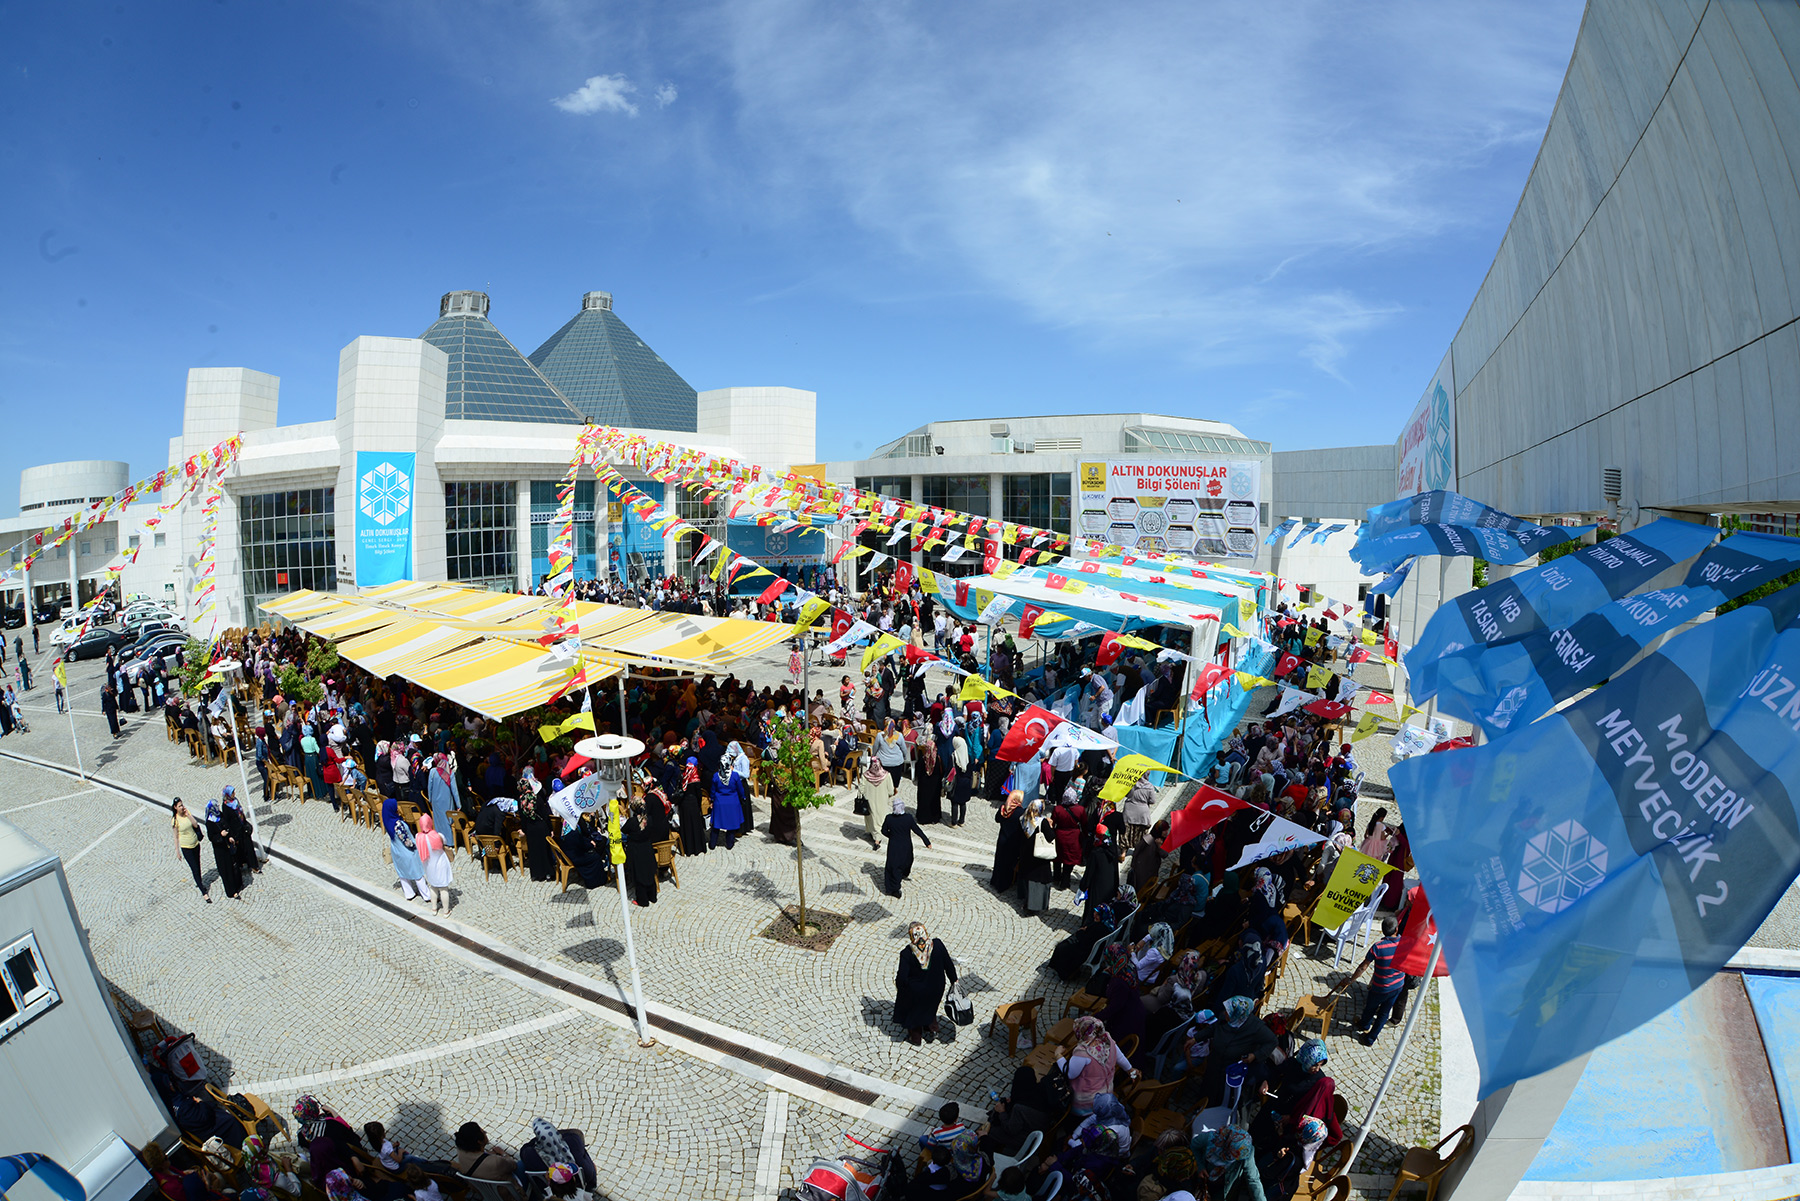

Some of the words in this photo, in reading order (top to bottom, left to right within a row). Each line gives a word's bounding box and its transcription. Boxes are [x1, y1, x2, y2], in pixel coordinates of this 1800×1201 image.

[1111, 465, 1144, 476] ALTIN
[1147, 465, 1227, 479] DOKUNUŞLAR
[1137, 478, 1162, 491] Bilgi
[1165, 478, 1200, 491] Şöleni
[1657, 713, 1754, 830] MODERN
[561, 796, 578, 820] KOMEK
[1696, 880, 1728, 917] 2
